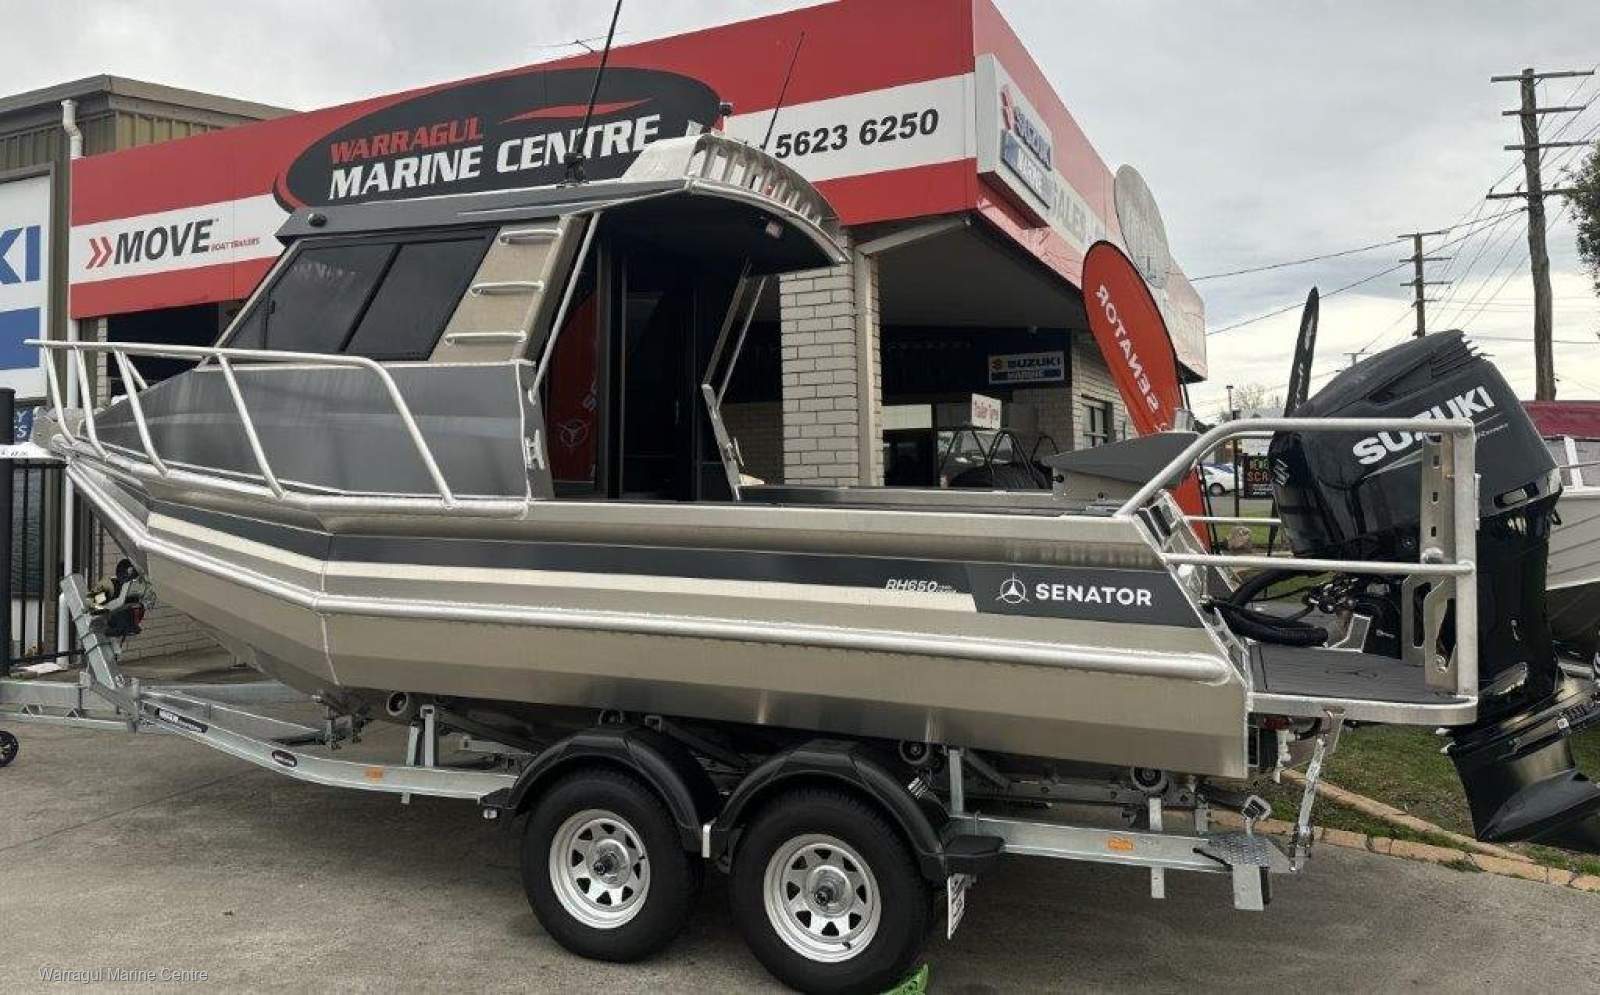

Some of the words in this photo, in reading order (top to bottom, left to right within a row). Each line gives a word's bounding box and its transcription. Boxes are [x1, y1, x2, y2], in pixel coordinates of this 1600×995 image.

[328, 146, 484, 200] MARINE
[496, 113, 662, 173] CENTRE
[330, 116, 483, 165] WARRAGUL
[774, 124, 848, 159] 5623
[859, 108, 939, 146] 6250
[113, 219, 214, 266] MOVE
[1008, 357, 1061, 369] SUZUKI
[1035, 583, 1153, 607] SENATOR
